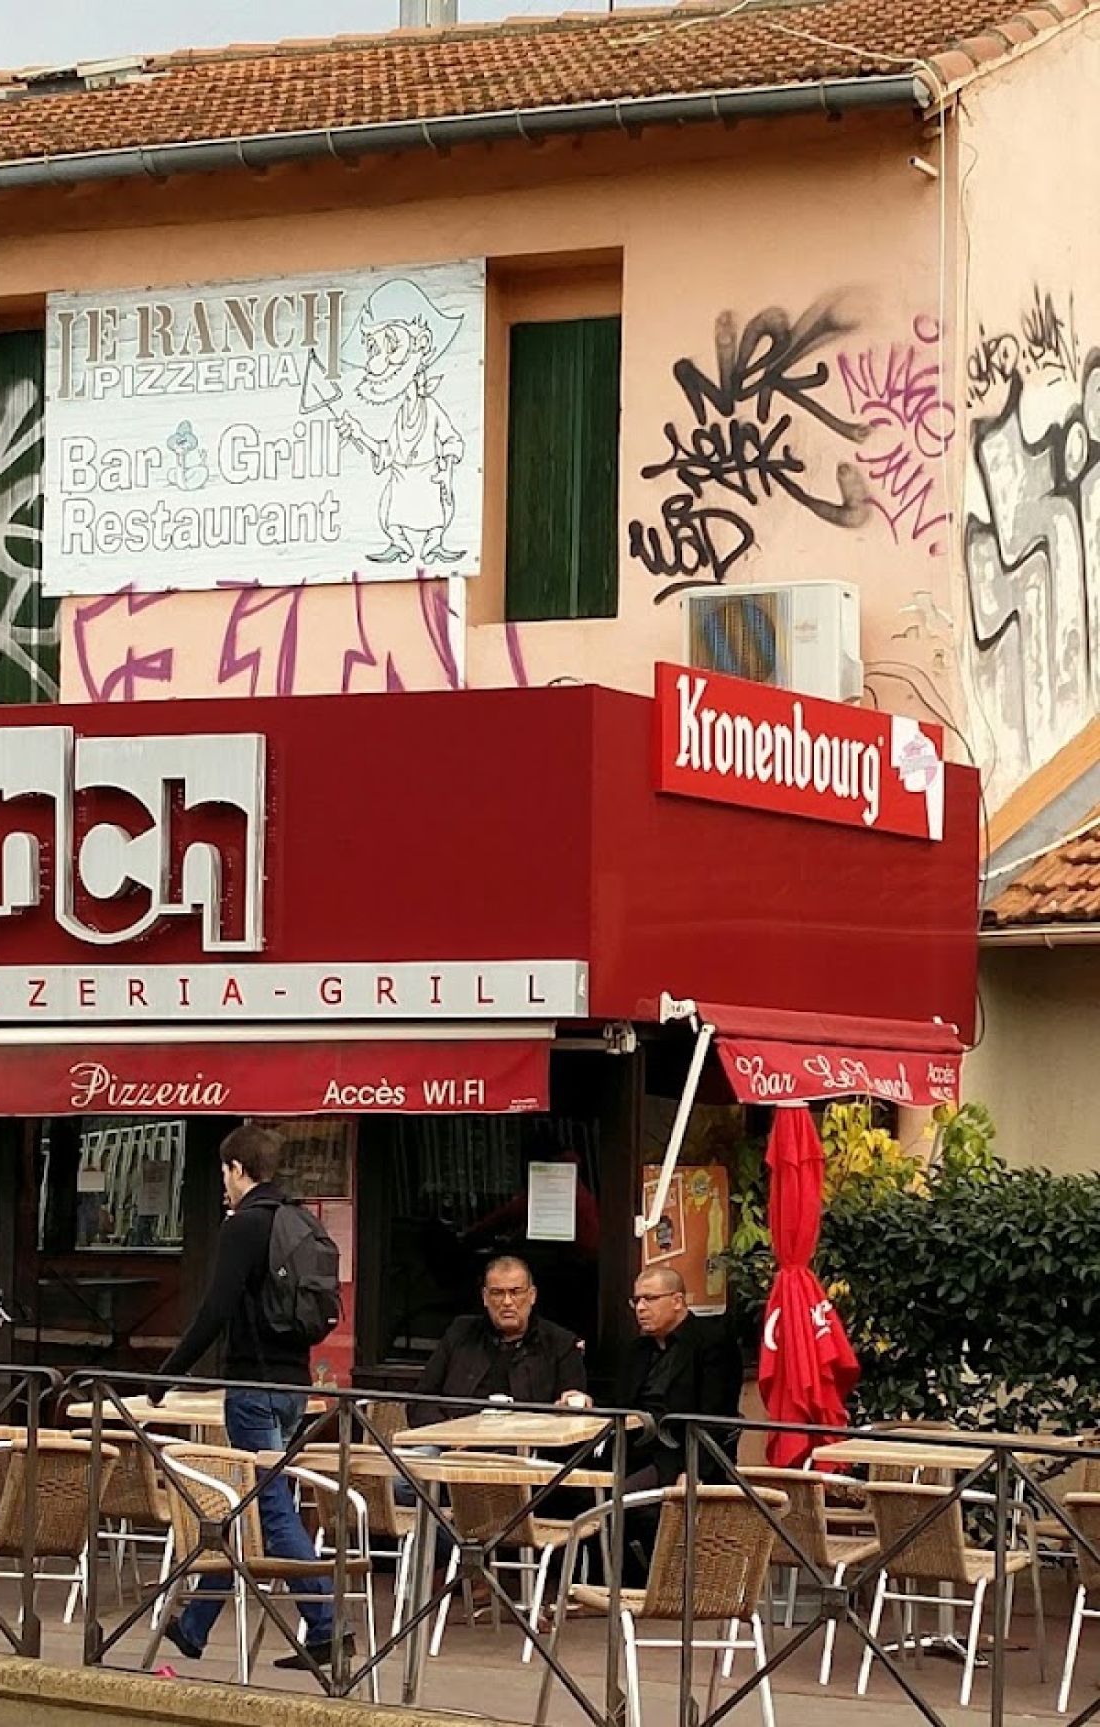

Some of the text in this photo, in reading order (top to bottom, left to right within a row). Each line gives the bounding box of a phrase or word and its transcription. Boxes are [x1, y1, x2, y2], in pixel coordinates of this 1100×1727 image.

[57, 289, 344, 399] LE RANCH
[92, 352, 302, 400] PIZZERIA
[60, 419, 341, 494] Bar Grill
[60, 489, 343, 555] Restaurant
[674, 673, 884, 826] Kronenbourg
[69, 1061, 231, 1108] Pizzeria
[322, 1076, 407, 1106] Accès
[422, 1078, 486, 1106] WI.FI
[736, 1055, 796, 1097] Bar
